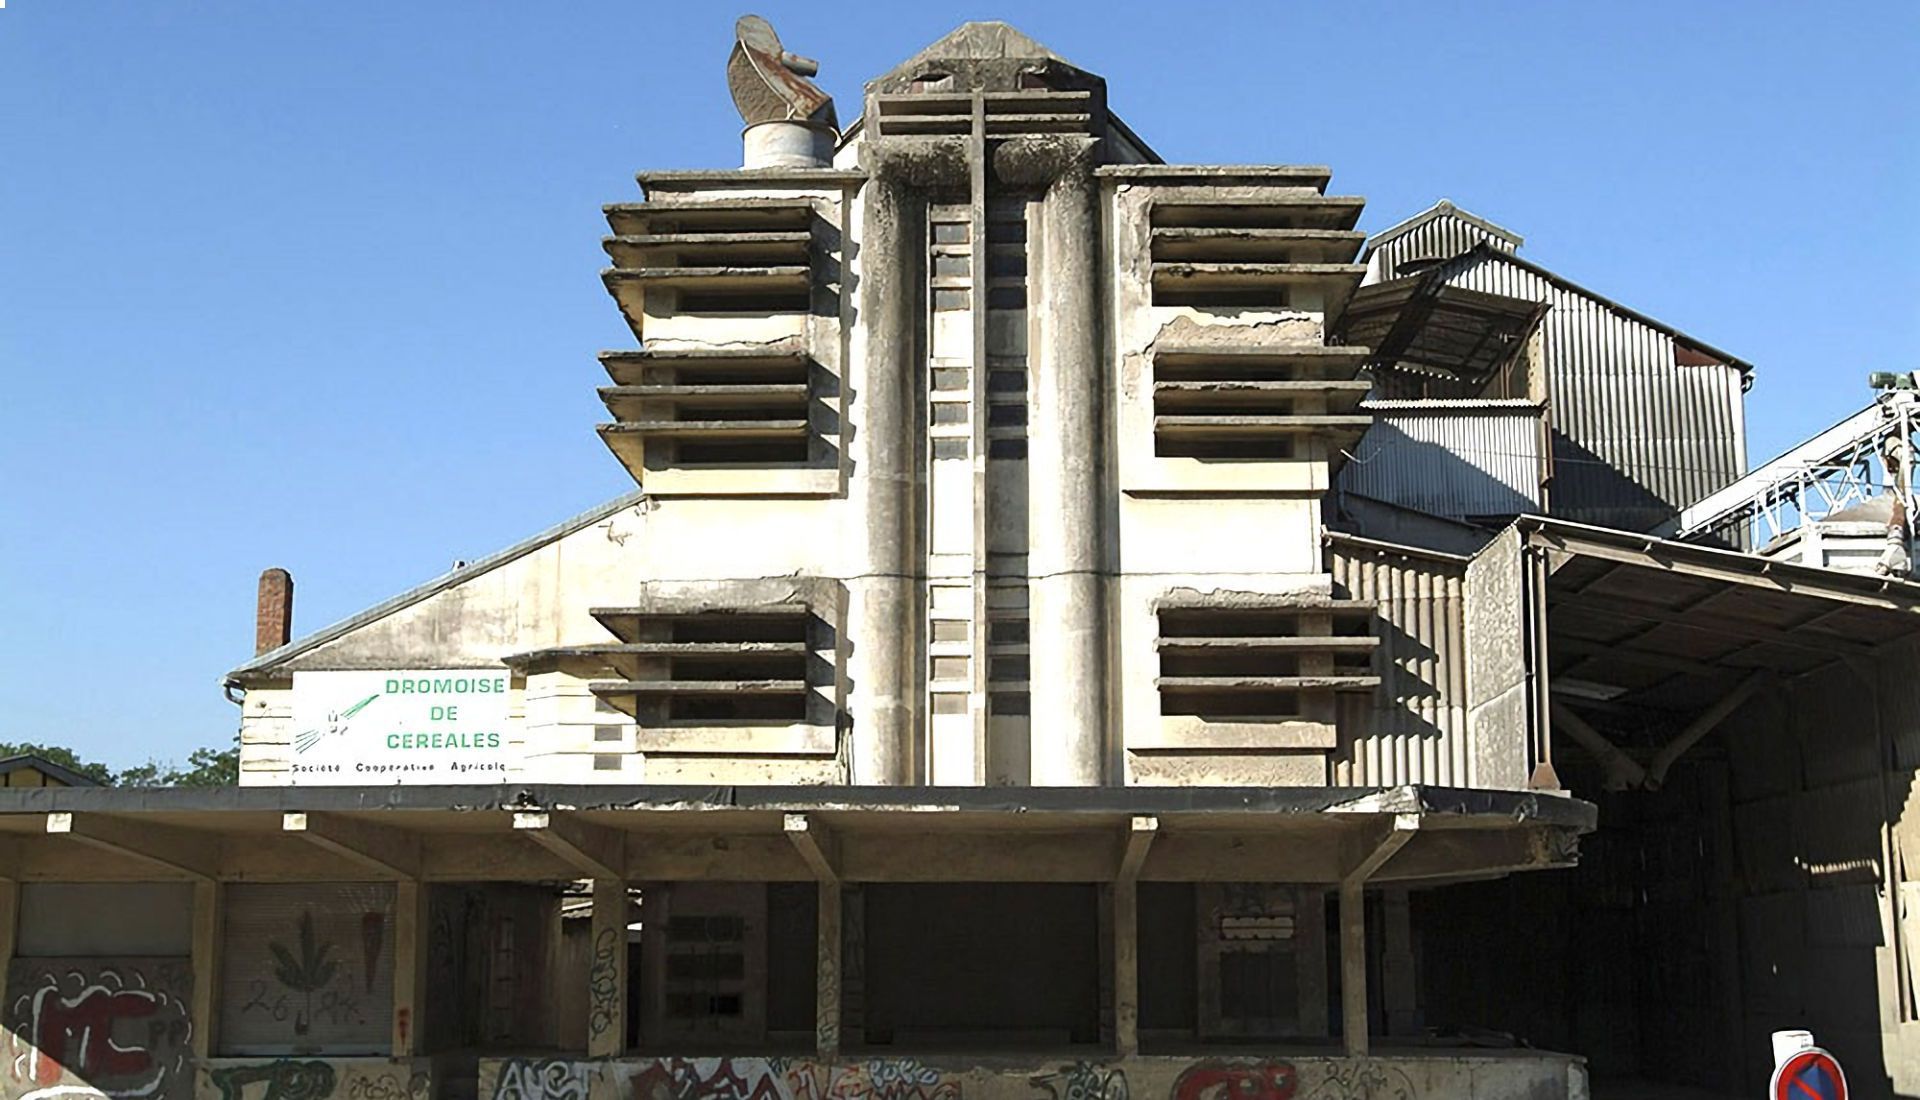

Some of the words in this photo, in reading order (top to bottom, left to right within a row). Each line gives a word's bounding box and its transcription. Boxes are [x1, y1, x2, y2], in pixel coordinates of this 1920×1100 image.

[385, 678, 505, 694] DROMOISE
[430, 706, 458, 721] DE
[387, 733, 500, 749] CEREALES
